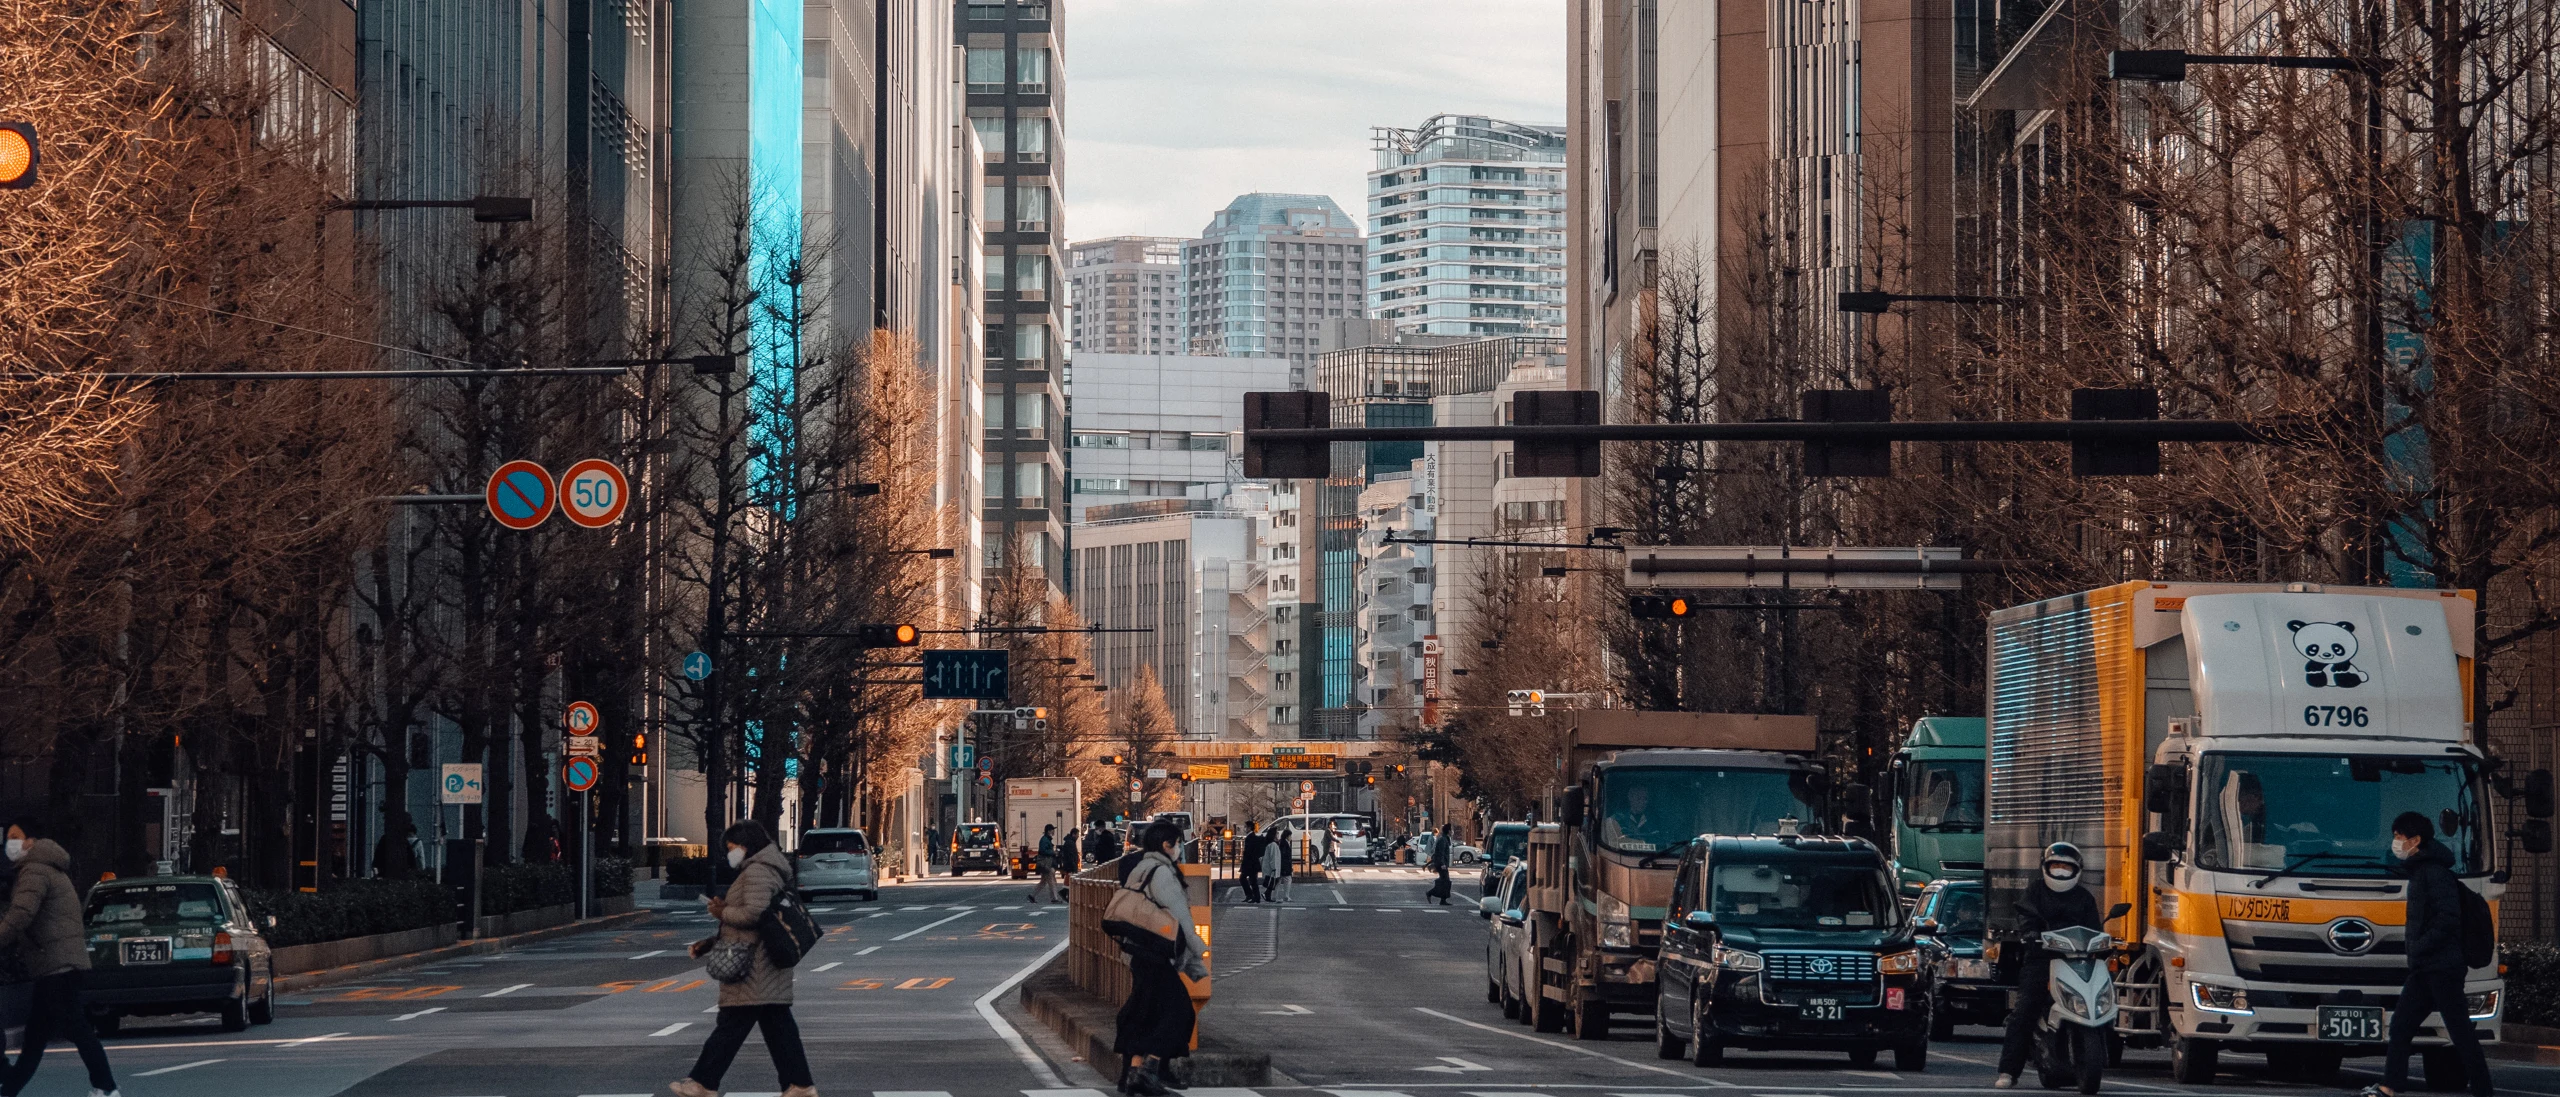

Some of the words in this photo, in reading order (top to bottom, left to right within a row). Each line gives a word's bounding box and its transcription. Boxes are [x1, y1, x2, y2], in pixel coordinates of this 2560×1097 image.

[575, 478, 612, 508] 50
[1425, 657, 1436, 699] 秋田銀行
[2304, 705, 2369, 728] 6796
[2229, 898, 2290, 921] パンダロジ大阪
[135, 950, 162, 961] 73-61
[2329, 1017, 2380, 1038] 50-13
